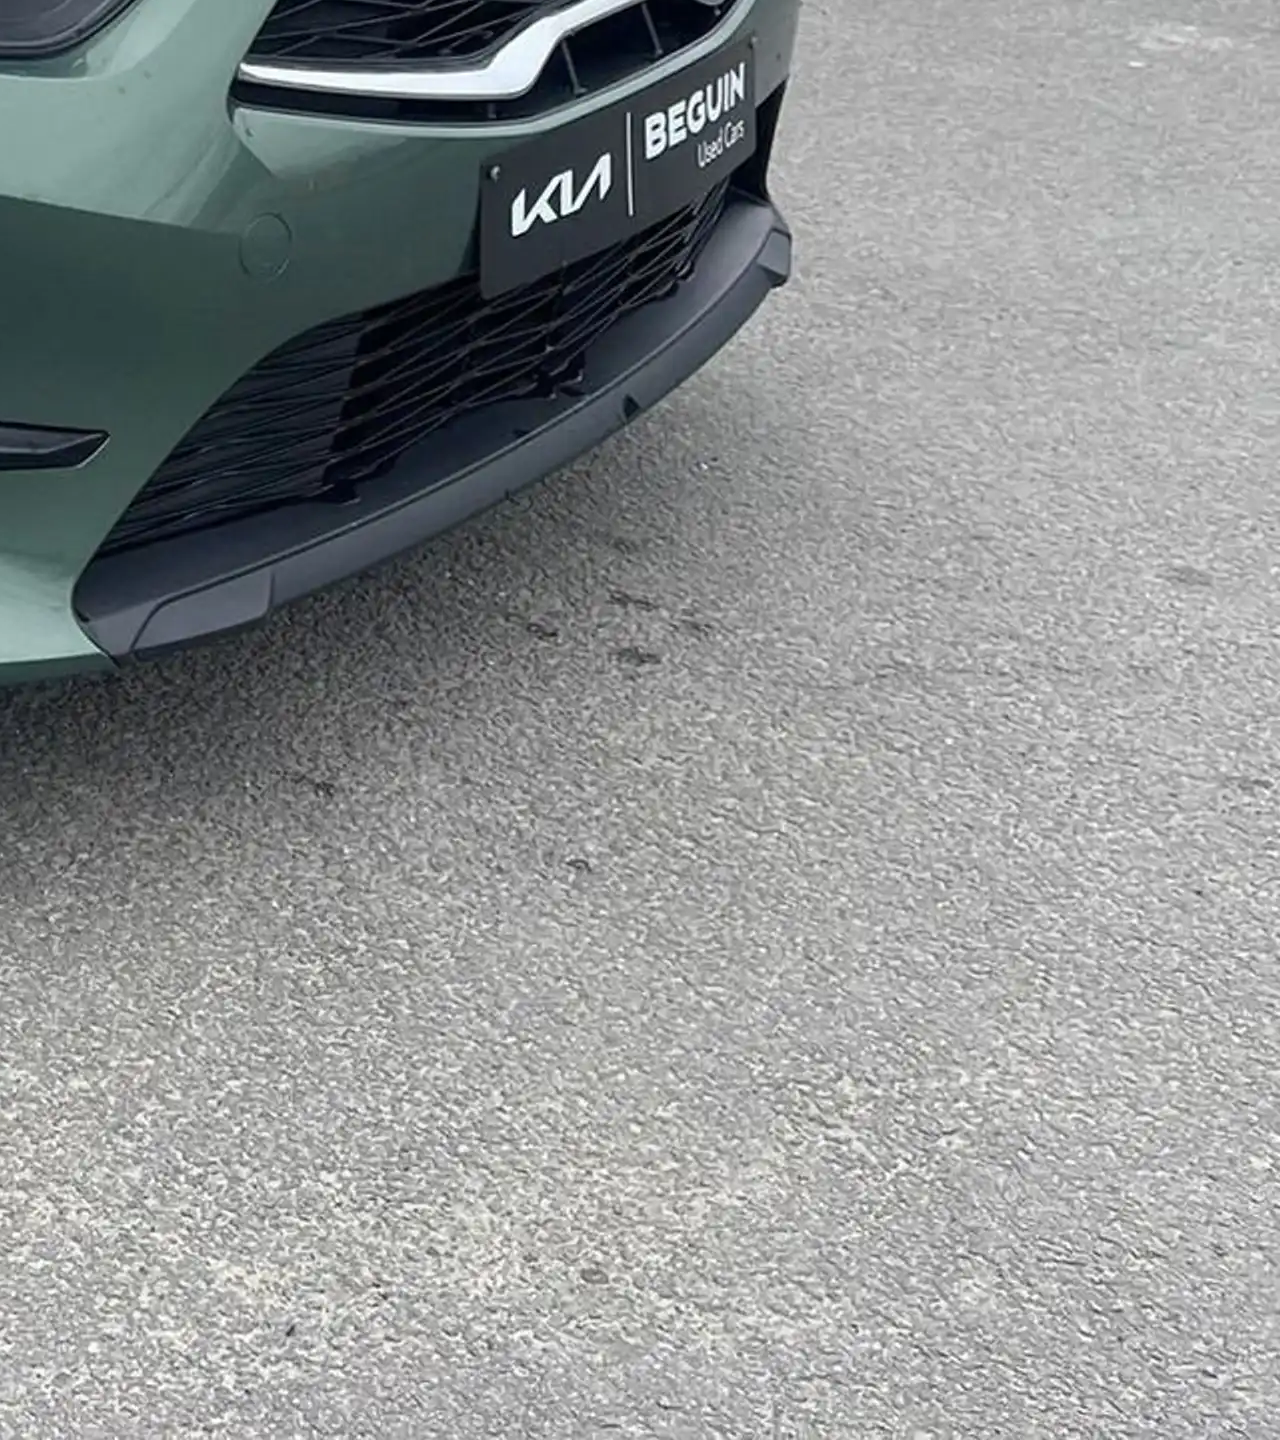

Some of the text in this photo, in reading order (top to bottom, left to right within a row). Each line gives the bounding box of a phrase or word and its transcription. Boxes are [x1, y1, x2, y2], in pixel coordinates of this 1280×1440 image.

[644, 61, 745, 160] BEGUIN
[697, 120, 744, 167] Used Cars
[511, 152, 611, 237] KIA
